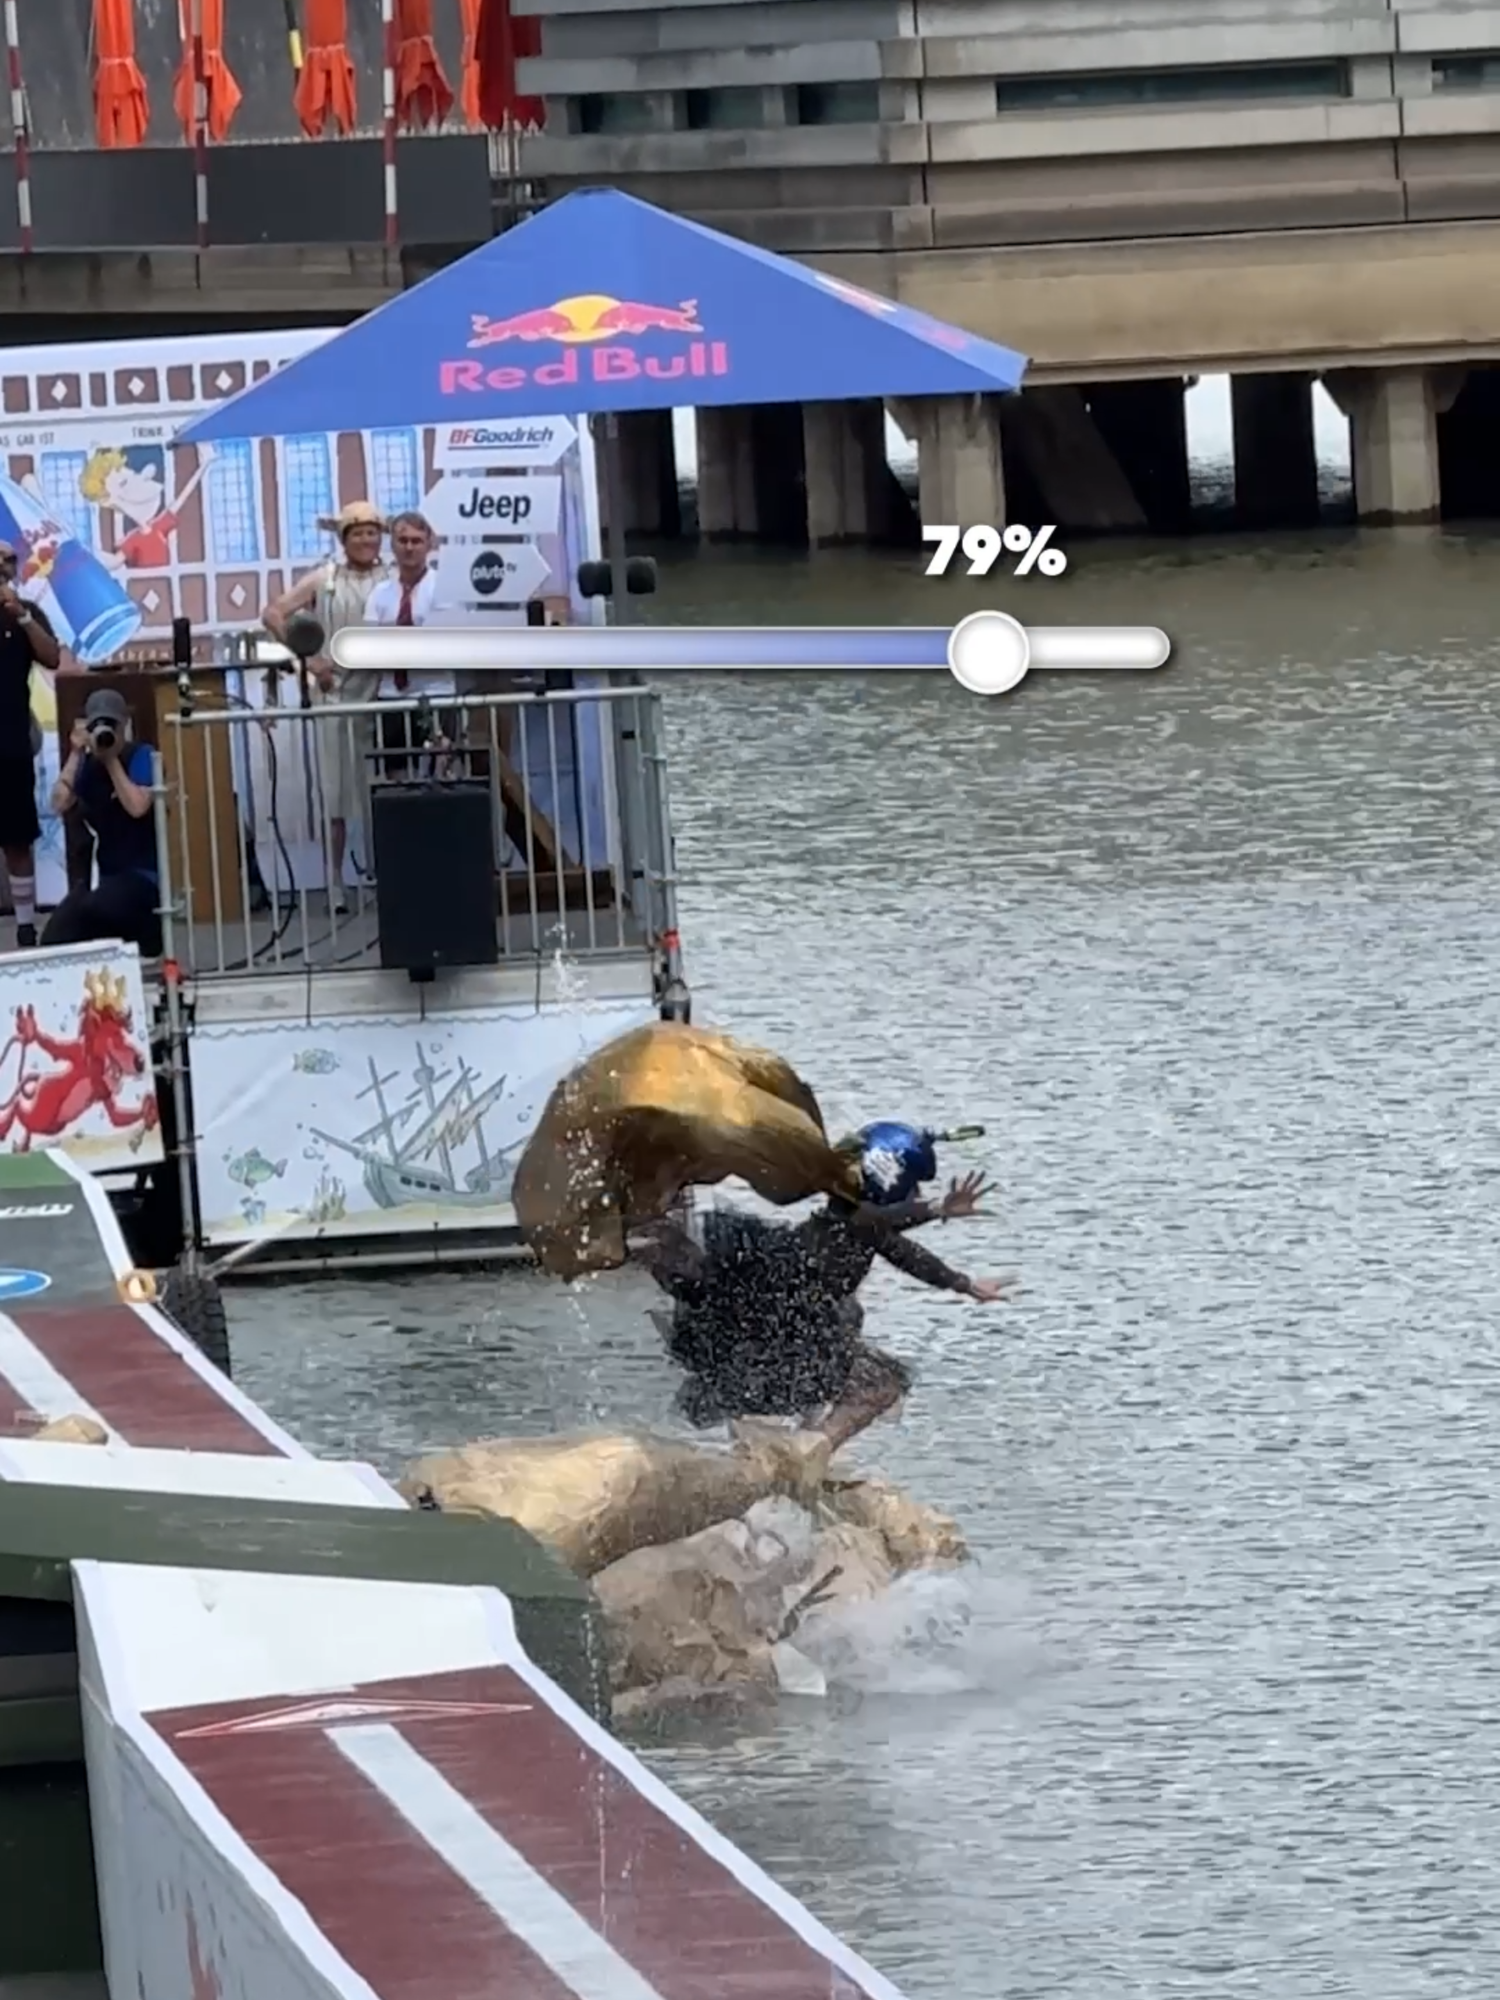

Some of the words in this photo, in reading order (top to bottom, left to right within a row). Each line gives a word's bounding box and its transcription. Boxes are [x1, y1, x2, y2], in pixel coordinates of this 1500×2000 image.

[440, 348, 577, 394] Red
[592, 342, 728, 382] Bull
[449, 426, 554, 444] BFGoodrich
[458, 486, 531, 525] Jeep
[471, 564, 505, 581] pluto
